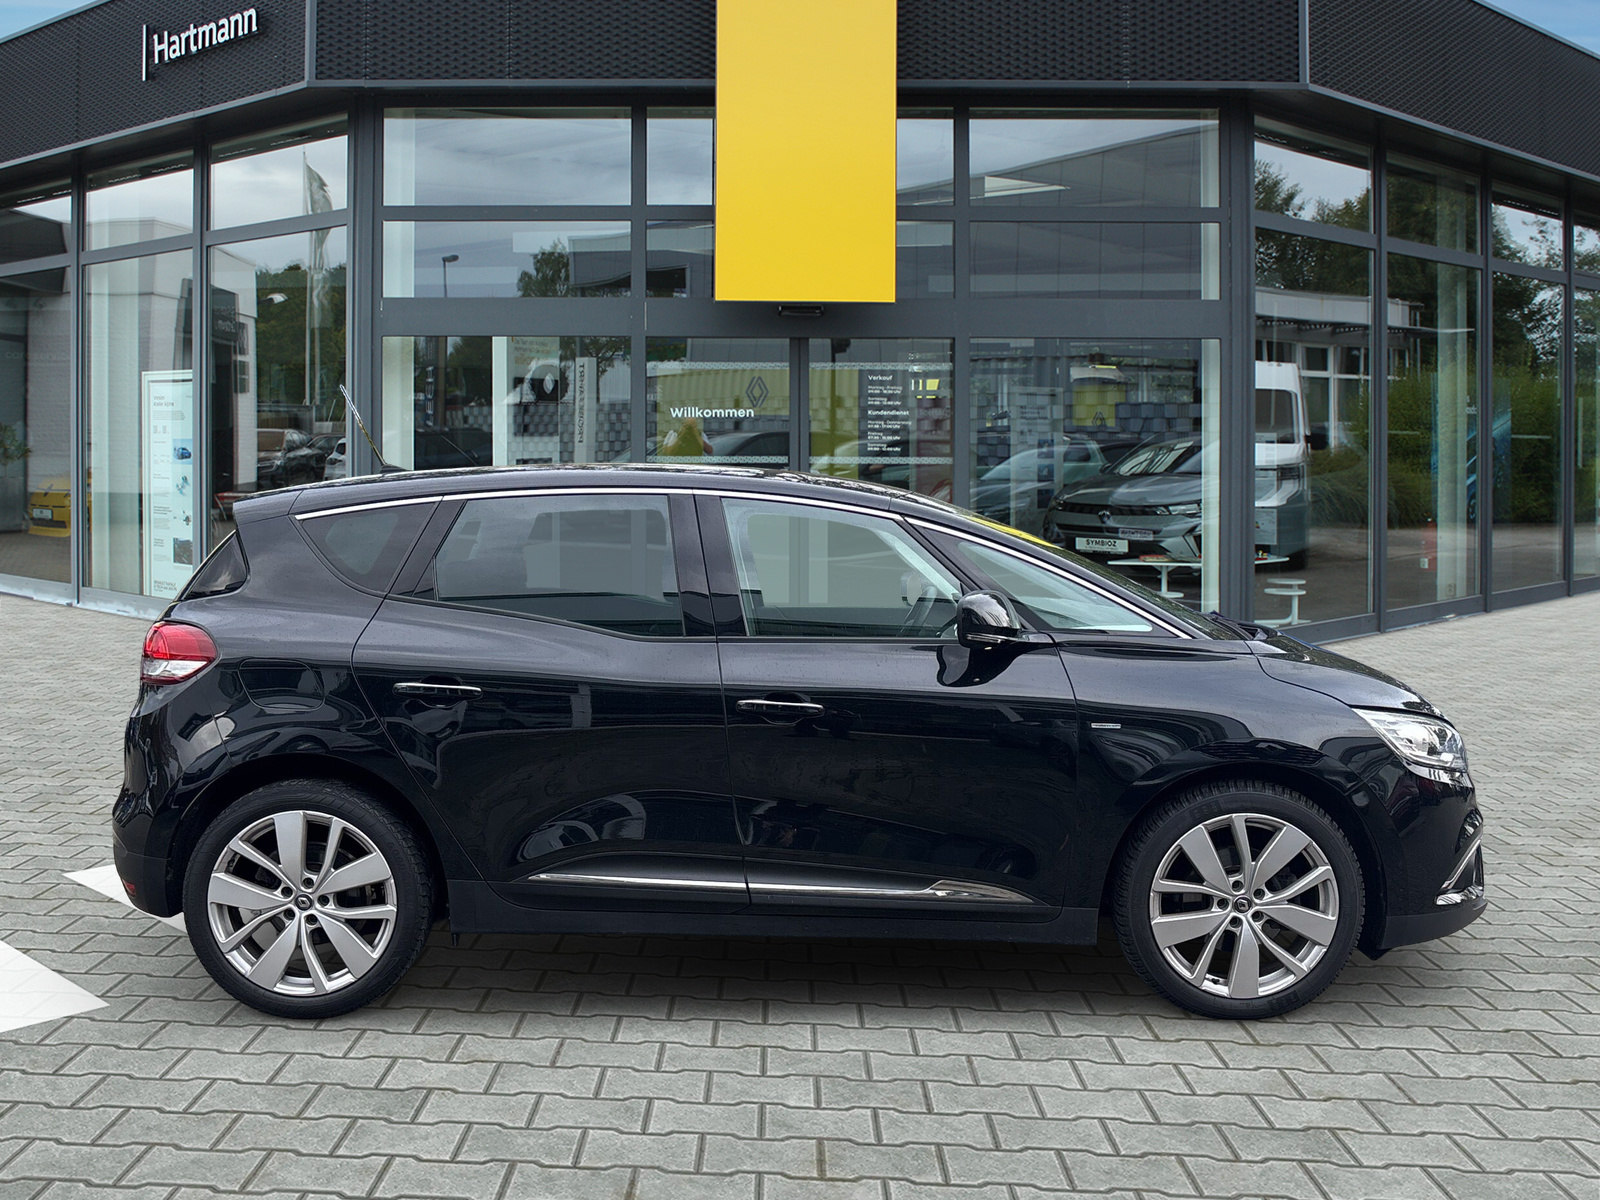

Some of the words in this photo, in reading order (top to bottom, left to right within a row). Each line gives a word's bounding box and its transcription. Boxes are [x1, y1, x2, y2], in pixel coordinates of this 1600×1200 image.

[153, 8, 257, 64] Hartmann
[669, 407, 755, 418] Willkommen
[1086, 539, 1117, 547] SYMBIOZ
